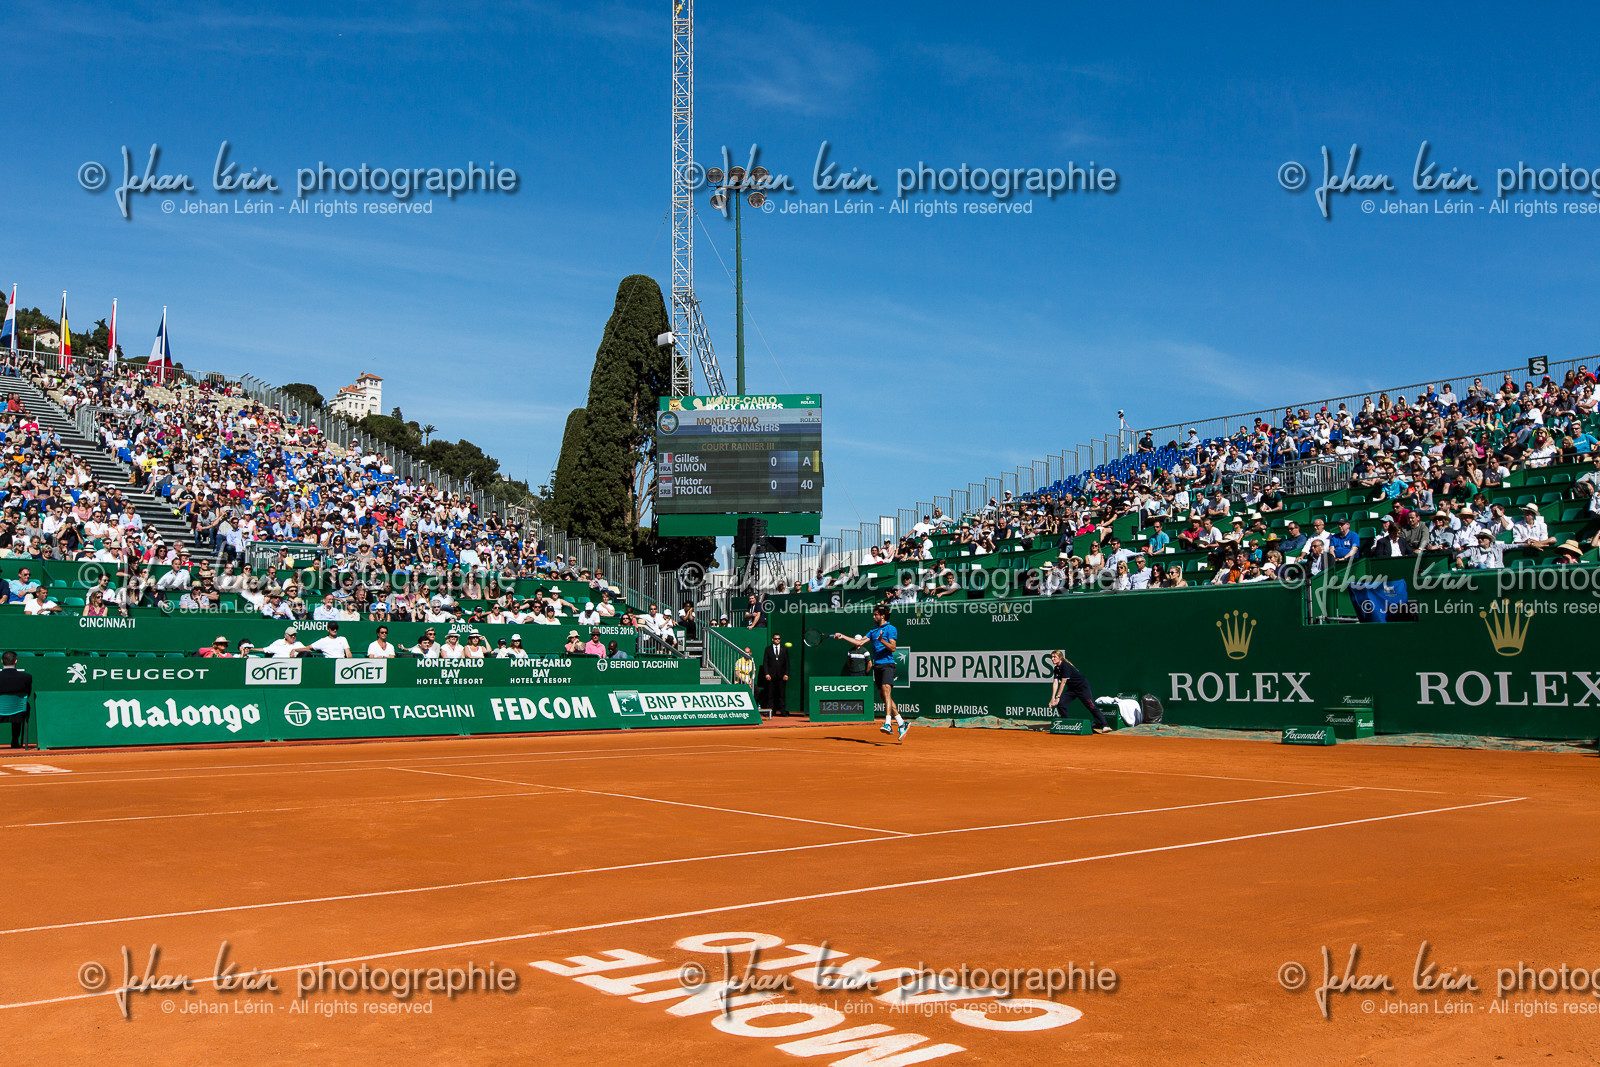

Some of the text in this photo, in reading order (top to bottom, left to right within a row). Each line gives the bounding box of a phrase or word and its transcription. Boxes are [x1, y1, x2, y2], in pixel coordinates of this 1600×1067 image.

[1532, 360, 1546, 375] S
[706, 397, 777, 405] MONTE-CARLO
[696, 417, 759, 425] MONTE-CARLO
[711, 424, 780, 433] ROLEX MASTERS
[732, 442, 764, 450] RAINIER
[766, 442, 775, 450] III
[675, 454, 700, 463] Gilles
[771, 457, 777, 467] 0
[802, 457, 811, 466] A
[675, 463, 707, 472] SIMON
[675, 477, 703, 485] Viktor
[771, 480, 777, 490] 0
[800, 480, 813, 489] 40
[464, 480, 470, 492] K
[675, 486, 712, 494] TROICKI
[831, 595, 841, 609] S
[907, 618, 931, 626] ROLEX
[992, 614, 1020, 623] ROLEX
[79, 618, 136, 629] CINCINNATI
[292, 621, 328, 631] SHANGH
[451, 624, 473, 633] PARIS
[620, 627, 634, 635] 2016
[417, 659, 484, 668] MONTE-CARLO
[510, 658, 572, 668] MONTE-CARLO
[610, 660, 679, 669] SERGIO TACCHINI
[916, 653, 1054, 679] BNP PARIBAS
[92, 669, 209, 680] PEUGEOT
[441, 669, 460, 678] BAY
[532, 669, 550, 677] BAY
[1168, 671, 1315, 703] ROLEX
[1416, 670, 1600, 707] ROLEX
[644, 694, 745, 709] BNP PARIBAS
[490, 696, 597, 721] FEDCOM
[822, 702, 839, 711] 128
[897, 703, 920, 713] RIBAS
[935, 705, 989, 715] BNP PARIBAS
[103, 698, 261, 733] Malongo
[316, 704, 475, 721] SERGIO TACCHINI
[659, 713, 682, 721] banque
[719, 712, 728, 720] qui
[729, 712, 750, 720] change
[1006, 707, 1060, 717] BNP PARIBA
[527, 948, 968, 1067] MONTE
